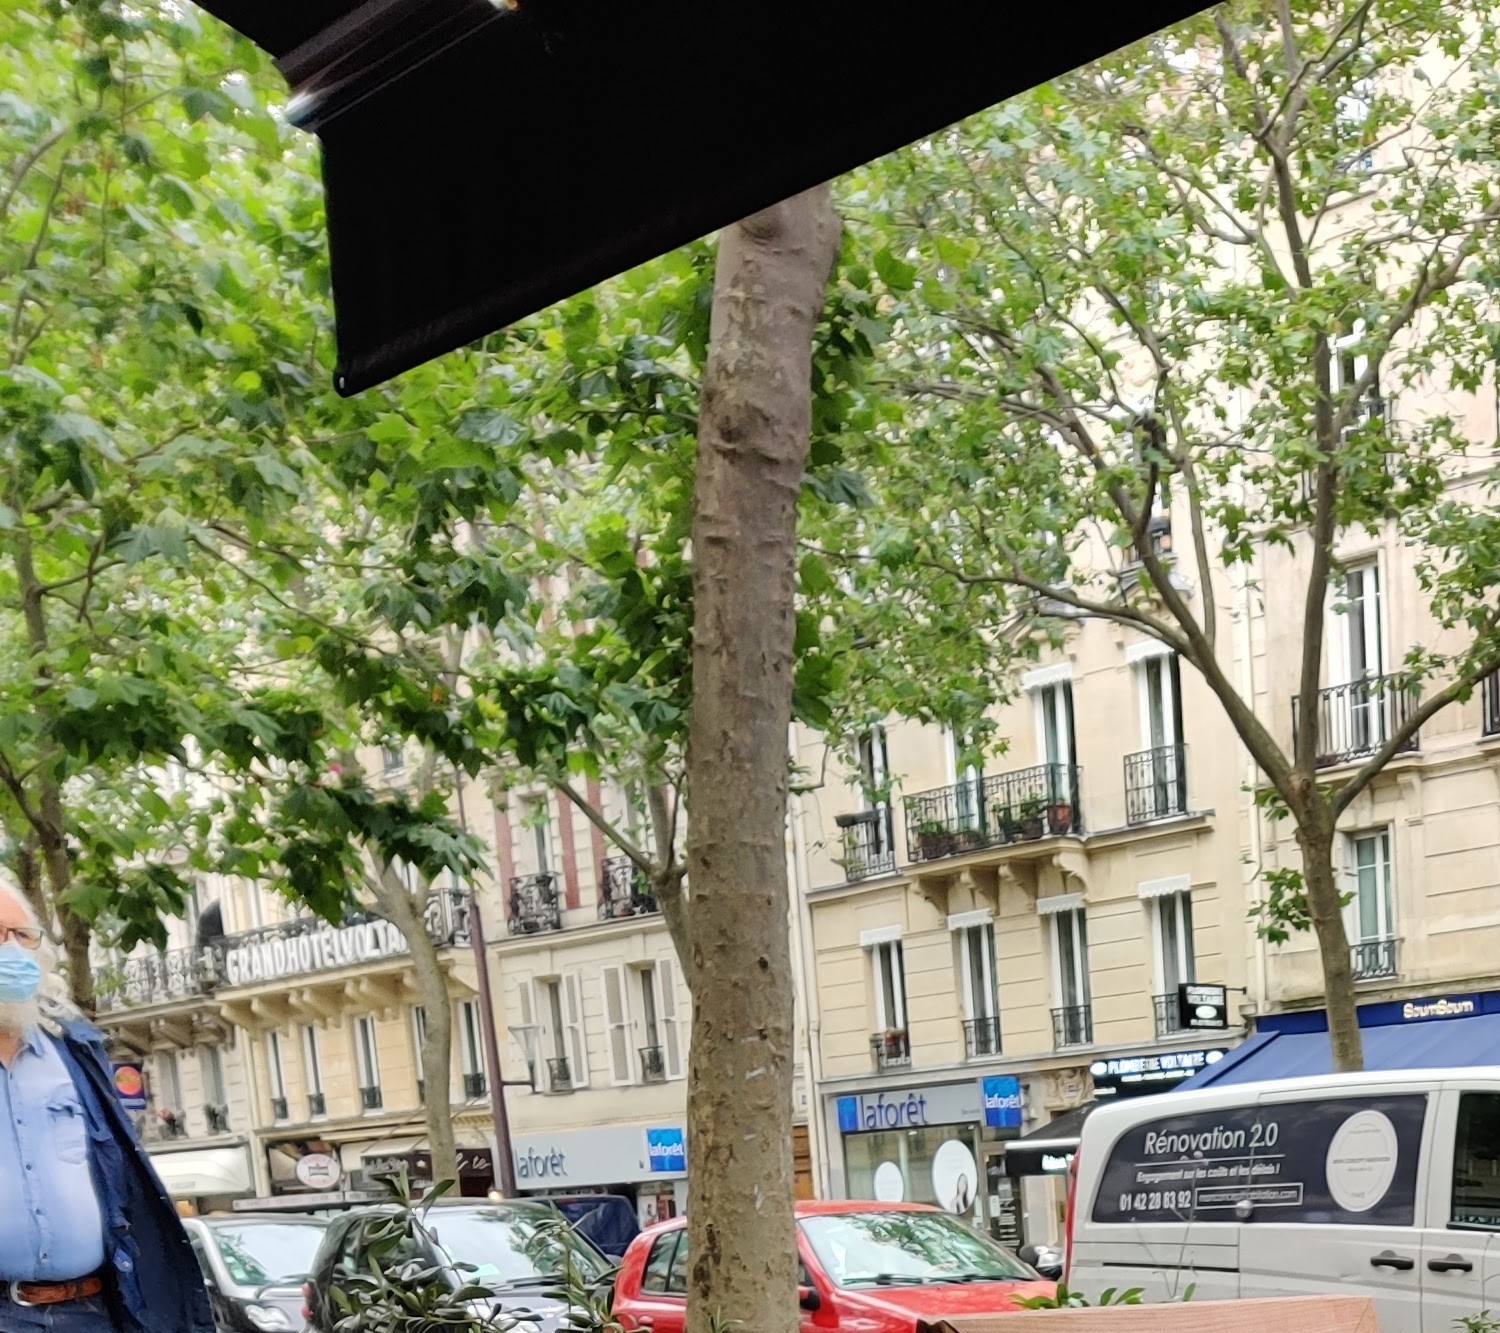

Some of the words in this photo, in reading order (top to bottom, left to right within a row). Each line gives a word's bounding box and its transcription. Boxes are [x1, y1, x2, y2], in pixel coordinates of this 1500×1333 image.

[861, 1093, 928, 1129] laforêt
[1144, 1125, 1246, 1155] Rénovation
[1248, 1121, 1279, 1148] 2.0
[515, 1146, 568, 1179] laforêt
